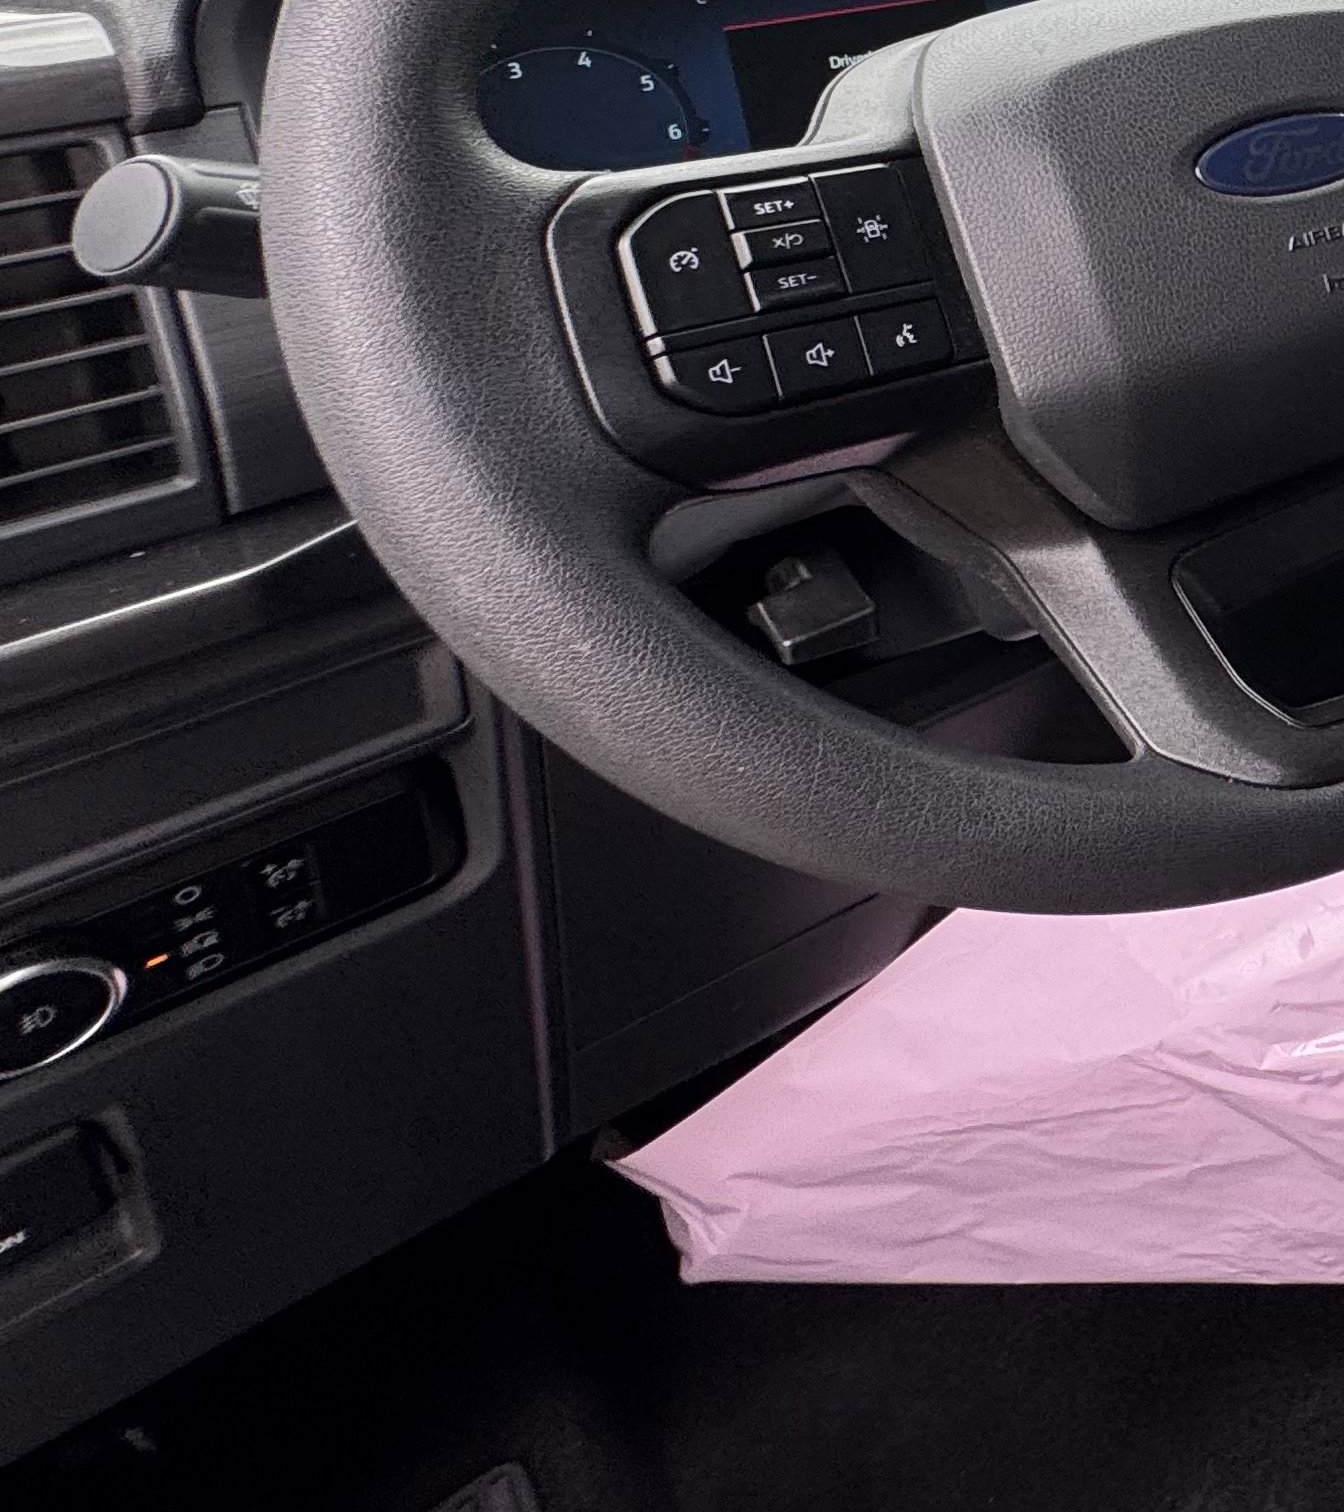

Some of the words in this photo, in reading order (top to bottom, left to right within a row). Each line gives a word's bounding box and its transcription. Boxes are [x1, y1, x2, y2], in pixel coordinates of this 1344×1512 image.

[577, 51, 592, 68] 4
[507, 62, 522, 79] 3
[640, 74, 655, 92] 5
[668, 124, 682, 140] 6
[754, 199, 795, 217] SET+
[778, 274, 818, 290] SET-
